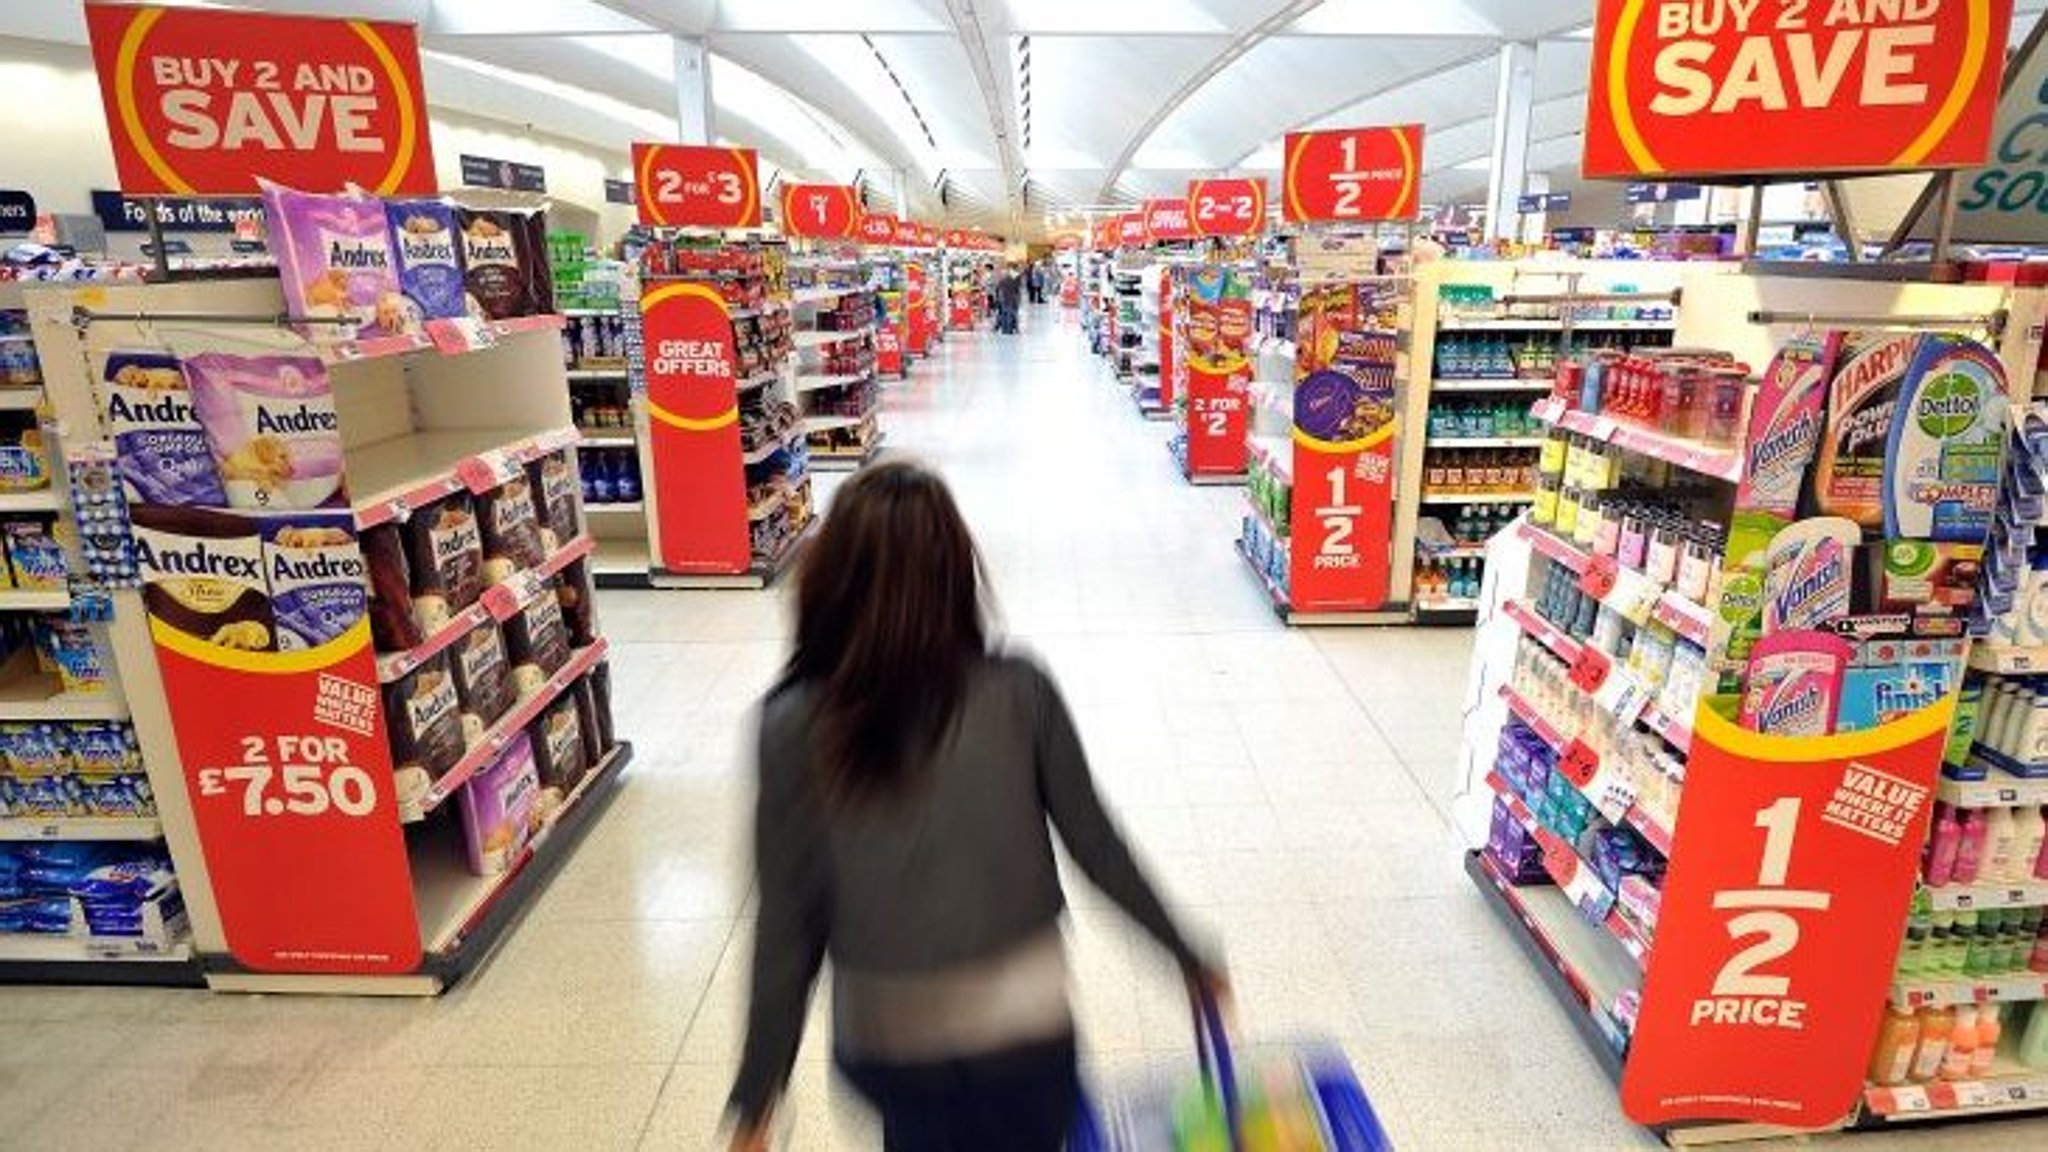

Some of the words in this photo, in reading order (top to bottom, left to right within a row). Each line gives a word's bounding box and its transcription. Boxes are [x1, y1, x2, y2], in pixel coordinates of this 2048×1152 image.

[1657, 0, 1758, 39] BUY
[1775, 0, 1809, 31] 2
[1824, 0, 1940, 27] AND
[152, 55, 239, 89] BUY
[254, 62, 281, 91] 2
[294, 63, 374, 94] AND
[1649, 25, 1935, 116] SAVE
[160, 89, 385, 154] SAVE
[656, 169, 684, 203] 2
[1334, 183, 1361, 216] 2
[123, 201, 175, 223] Fods
[179, 203, 195, 223] of
[198, 204, 223, 223] the
[1200, 198, 1216, 219] 2
[331, 240, 388, 269] Andrex
[653, 359, 730, 378] OFFERS
[659, 340, 724, 360] GREAT
[109, 392, 201, 424] Andre
[1194, 398, 1206, 412] 2
[1212, 398, 1241, 411] FOR
[1920, 397, 1980, 417] Dettol
[1326, 466, 1345, 507] 1
[1321, 516, 1354, 554] 2
[134, 537, 260, 580] Andrex
[1314, 554, 1362, 569] PRICE
[1776, 555, 1842, 624] Vanish
[318, 678, 377, 708] VALUE
[1758, 683, 1818, 733] Vanish
[241, 736, 268, 762] 2
[277, 736, 350, 763] FOR
[199, 765, 377, 816] £7.50
[1834, 786, 1893, 818] WHERE
[1892, 809, 1914, 826] IT
[1843, 767, 1927, 812] VALUE
[1825, 800, 1905, 838] MATTERS
[1754, 797, 1802, 887] 1
[1711, 911, 1800, 997] 2
[1690, 999, 1807, 1029] PRICE
